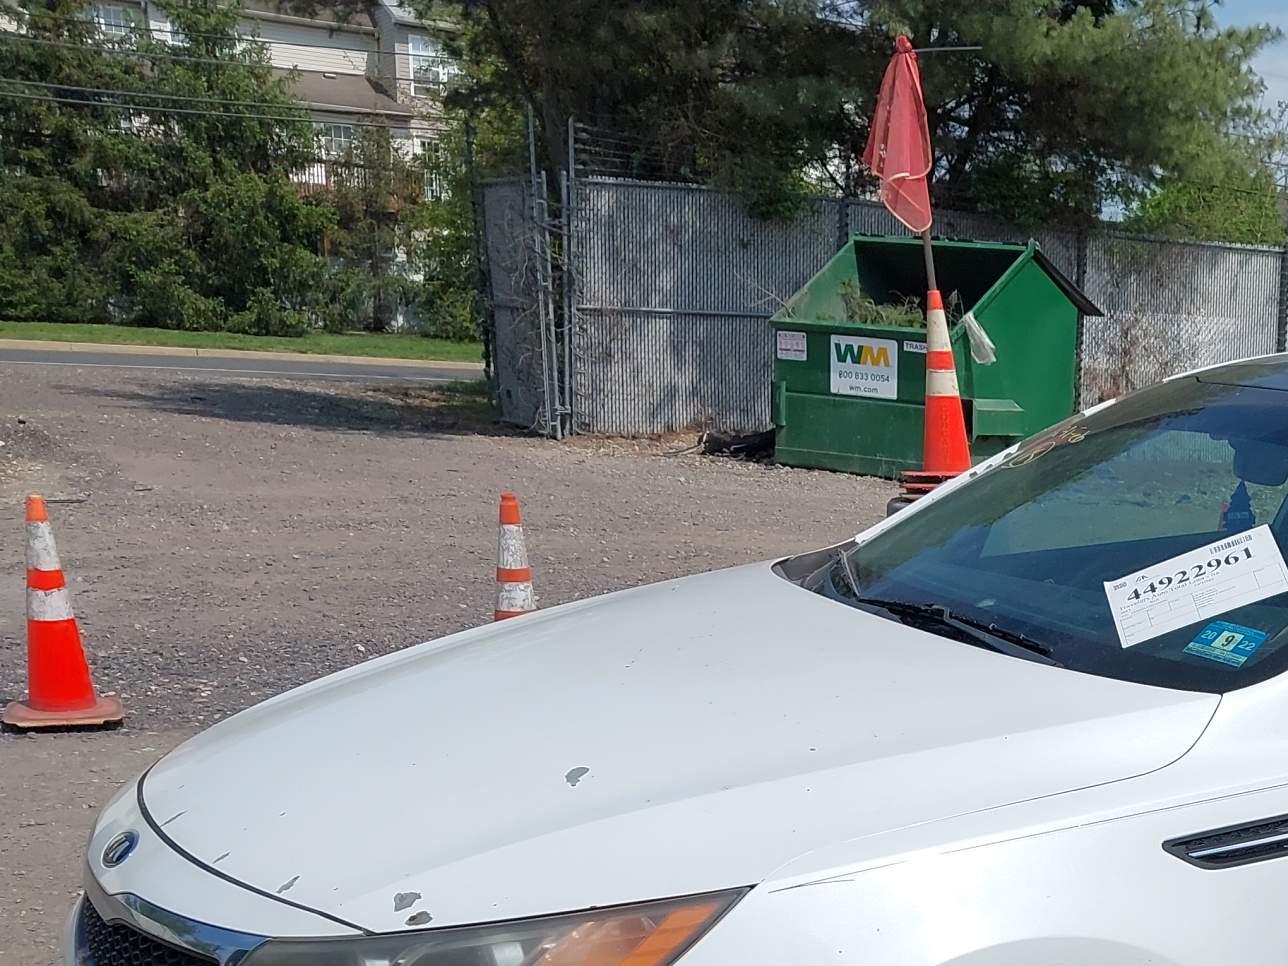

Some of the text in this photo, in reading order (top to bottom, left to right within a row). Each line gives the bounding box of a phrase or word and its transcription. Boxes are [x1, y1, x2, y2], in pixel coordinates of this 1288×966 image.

[834, 342, 891, 368] WM
[838, 370, 890, 383] 800 833 0054
[849, 386, 879, 394] wm.com
[1127, 546, 1253, 600] 44922961
[1201, 630, 1256, 651] 20 9 22
